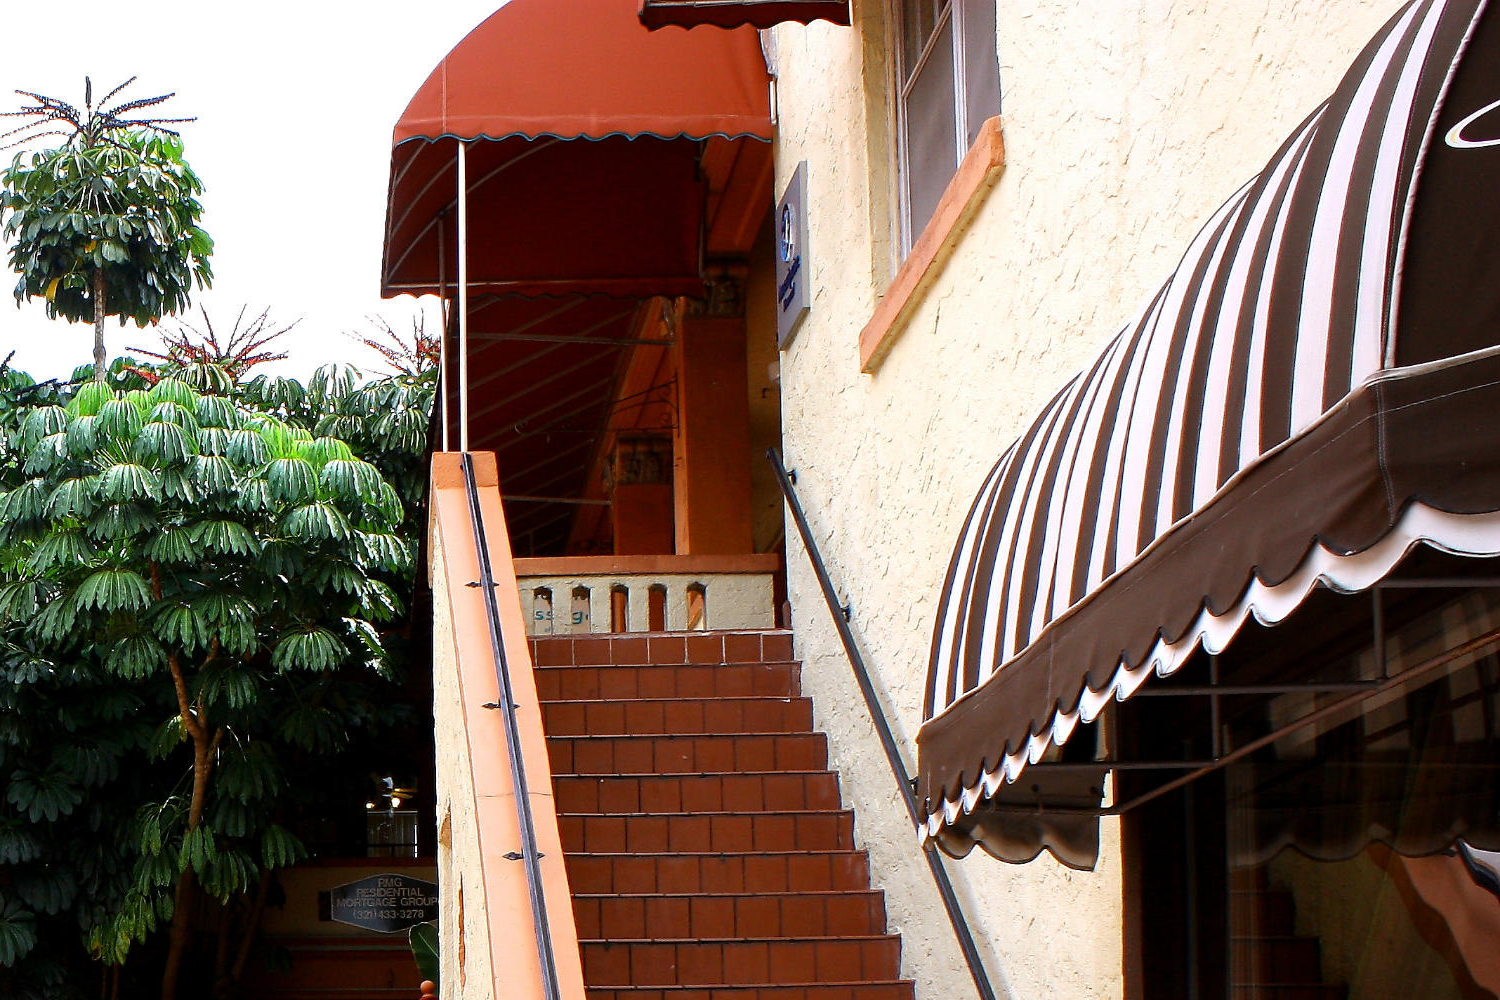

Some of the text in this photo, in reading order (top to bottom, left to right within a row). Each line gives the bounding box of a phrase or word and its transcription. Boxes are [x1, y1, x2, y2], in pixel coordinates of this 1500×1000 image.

[356, 887, 424, 897] RESIDENTIAL
[336, 897, 437, 907] MORTGAGE GROUP
